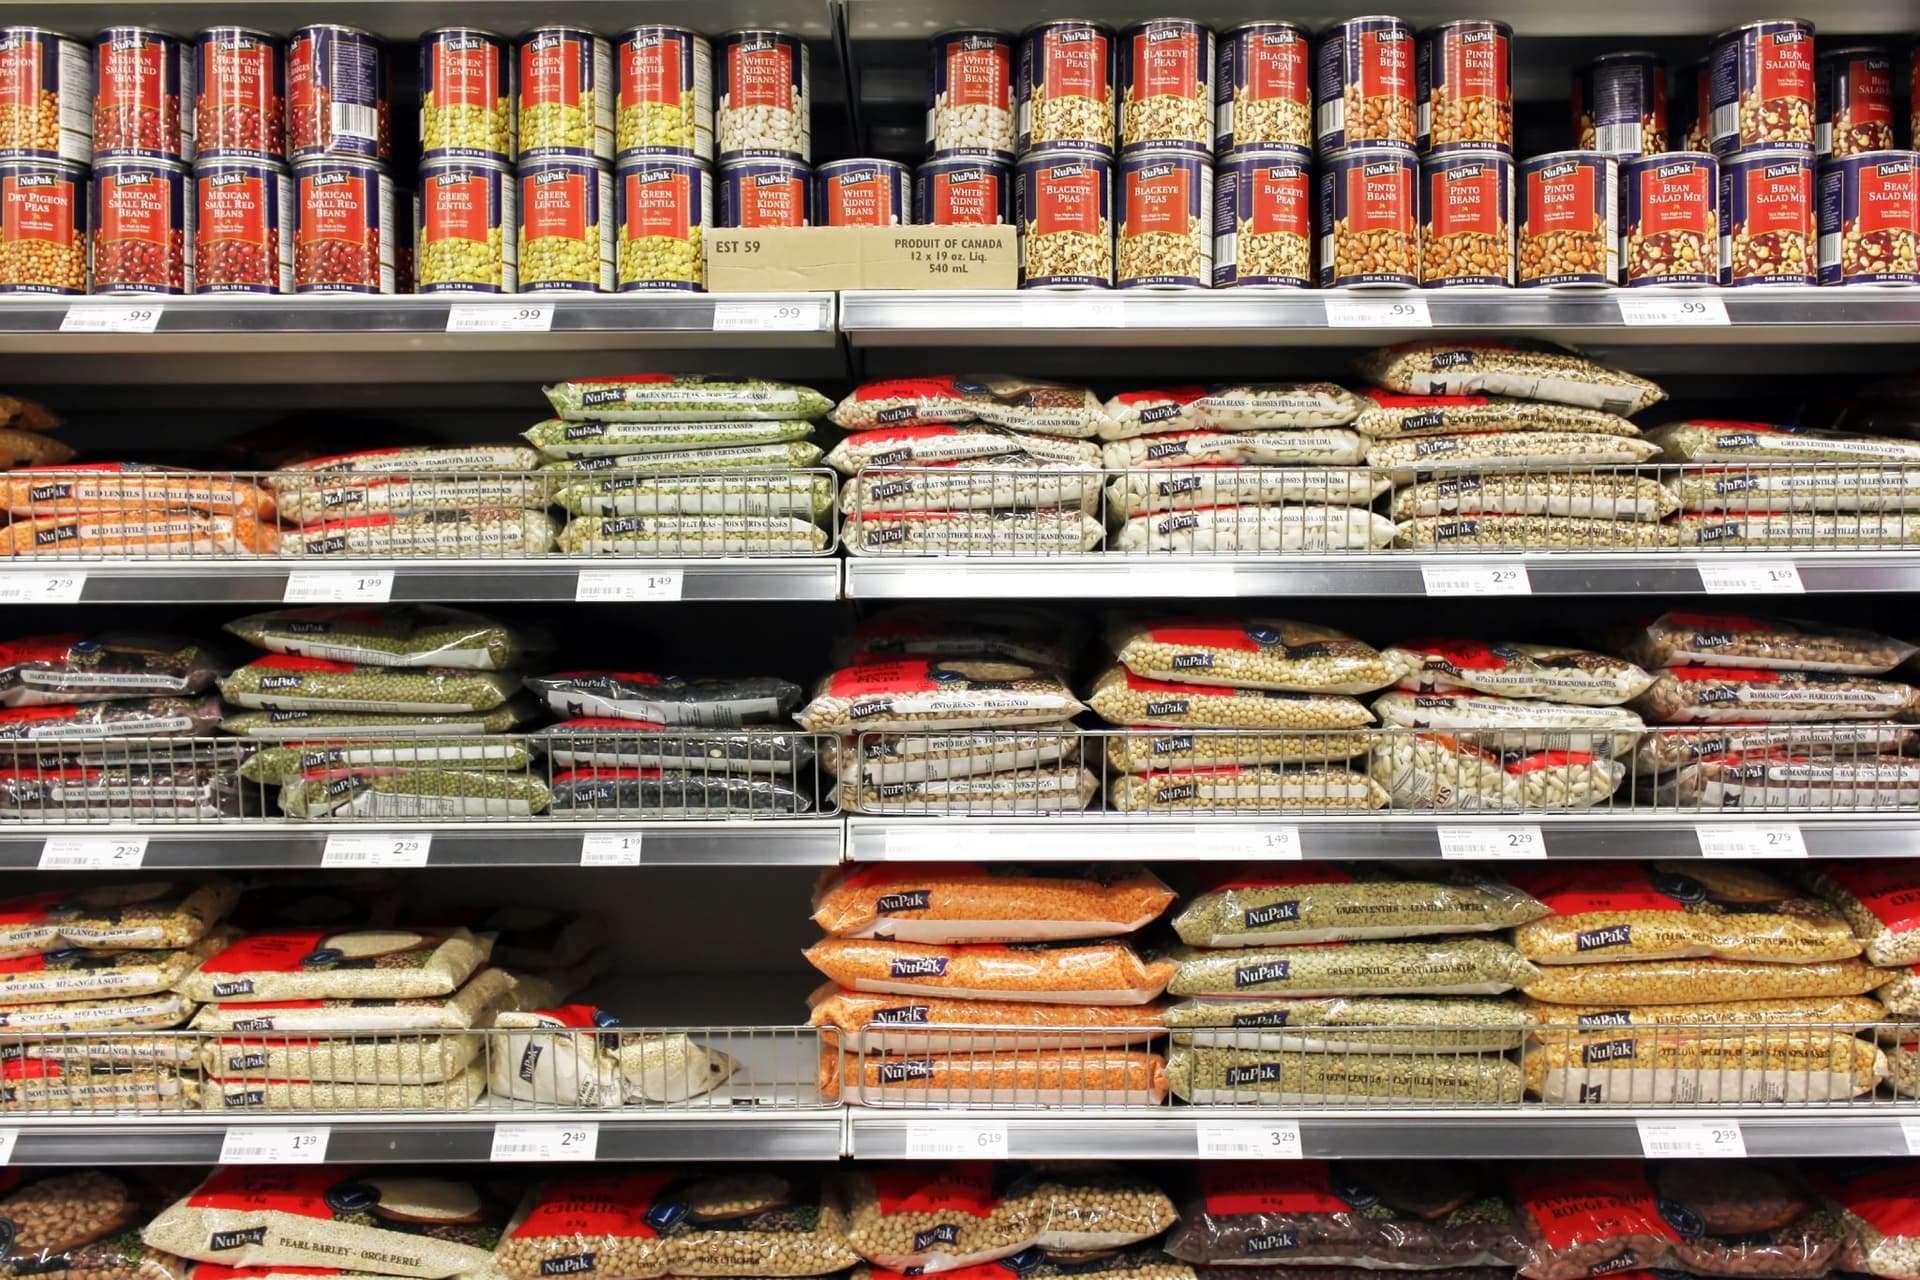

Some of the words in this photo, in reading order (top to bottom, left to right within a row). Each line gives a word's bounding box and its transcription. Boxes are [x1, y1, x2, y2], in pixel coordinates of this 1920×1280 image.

[1062, 32, 1091, 42] NuPak
[1150, 31, 1179, 42] NuPak
[1464, 32, 1492, 43] NuPak
[743, 40, 772, 51] NuPak
[1053, 166, 1083, 178] NuPak
[1141, 166, 1171, 178] NuPak
[1272, 168, 1298, 178] NuPak
[1366, 164, 1396, 176] NuPak
[1449, 167, 1479, 179] NuPak
[1543, 165, 1573, 179] NuPak
[1660, 166, 1690, 178] NuPak
[1768, 166, 1797, 177] NuPak
[1880, 164, 1909, 176] NuPak
[19, 176, 52, 186] NuPak
[117, 175, 148, 185] NuPak
[211, 175, 242, 185] NuPak
[314, 173, 344, 184] NuPak
[438, 174, 467, 185] NuPak
[536, 173, 565, 184] NuPak
[640, 172, 670, 183] NuPak
[757, 175, 786, 186] NuPak
[842, 172, 872, 185] NuPak
[951, 171, 980, 182] NuPak
[1135, 186, 1179, 195] BLACKEYE
[1367, 183, 1396, 191] PINTO
[1450, 186, 1480, 195] PINTO
[1545, 184, 1574, 193] PINTO
[1663, 184, 1689, 192] BEAN
[1771, 184, 1796, 193] BEAN
[1884, 182, 1908, 190] BEAN
[8, 193, 27, 201] DRY
[30, 194, 67, 206] PIGEON
[113, 191, 156, 200] MEXICAN
[311, 191, 352, 199] MEXICAN
[438, 192, 469, 200] GREEN
[536, 191, 567, 199] GREEN
[641, 190, 672, 199] GREEN
[1058, 194, 1080, 203] PEAS
[1145, 194, 1167, 203] PEAS
[1367, 192, 1397, 201] BEANS
[1450, 195, 1480, 204] BEANS
[1544, 194, 1575, 203] BEANS
[1650, 195, 1681, 203] SALAD
[1757, 194, 1787, 203] SALAD
[1869, 192, 1900, 200] SALAD
[25, 203, 50, 212] PEAS
[108, 200, 138, 208] SMALL
[140, 201, 161, 209] RED
[338, 201, 357, 209] RED
[639, 200, 675, 208] LENTILS
[842, 198, 875, 207] KIDNEY
[119, 209, 150, 218] BEANS
[214, 209, 243, 217] BEANS
[317, 209, 346, 217] BEANS
[845, 207, 873, 216] BEANS
[716, 241, 738, 253] EST
[745, 241, 760, 253] 59
[895, 239, 940, 248] PRODUIT
[945, 239, 957, 248] OF
[962, 239, 1002, 248] CANADA
[911, 252, 921, 261] 12
[937, 252, 947, 261] 19
[951, 253, 966, 261] oz.
[969, 252, 987, 263] Liq.
[929, 264, 948, 273] 540
[953, 264, 968, 273] mL
[584, 390, 621, 404] NuPak
[880, 408, 913, 421] NuPak
[921, 409, 943, 417] GREAT
[1404, 416, 1440, 429] NuPak
[938, 448, 976, 456] NORTHERN
[1696, 635, 1728, 646] NuPak
[1175, 655, 1209, 667] NuPak
[261, 677, 298, 688] NuPak
[852, 700, 888, 718] NuPak
[1149, 703, 1183, 714] NuPak
[1157, 739, 1191, 752] NuPak
[879, 894, 924, 909] NuPak
[1249, 906, 1294, 925] NuPak
[1580, 930, 1625, 948] NuPak
[1239, 964, 1285, 984] NuPak
[215, 982, 250, 995] NuPak
[215, 1233, 261, 1248] NuPak
[1248, 1234, 1293, 1252] NuPak
[280, 1238, 309, 1249] PEARL
[312, 1243, 351, 1256] BARLEY
[361, 1251, 387, 1262] ORGE
[390, 1255, 422, 1267] PERLÉ
[544, 1257, 589, 1273] NuPak
